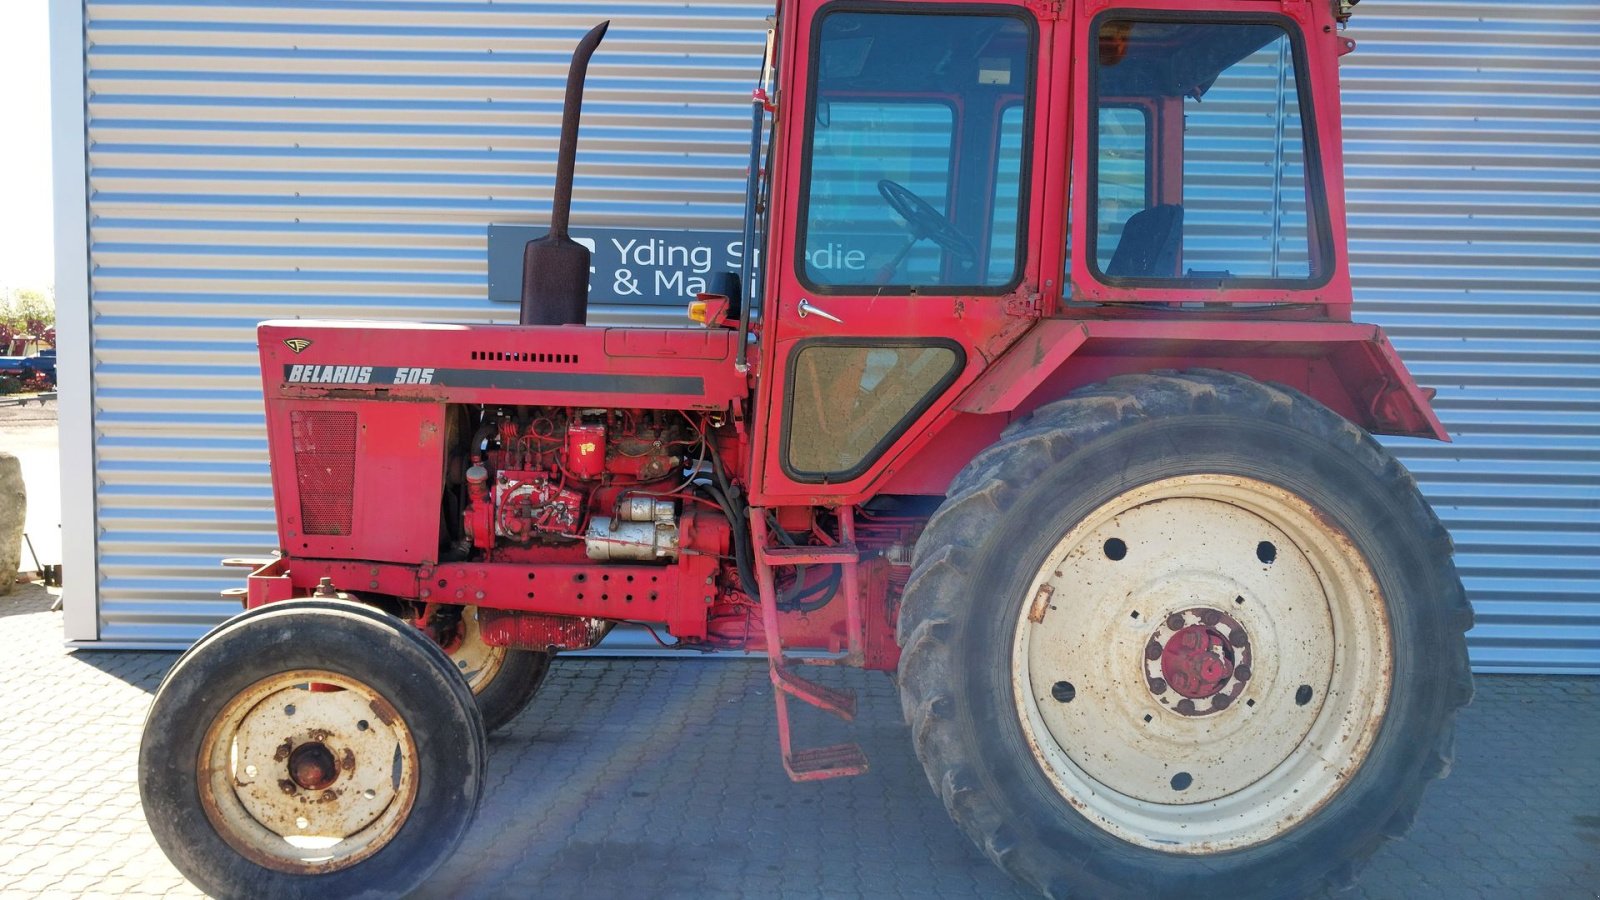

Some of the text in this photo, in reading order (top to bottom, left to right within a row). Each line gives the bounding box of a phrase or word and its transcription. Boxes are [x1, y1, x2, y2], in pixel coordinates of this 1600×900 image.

[611, 238, 712, 273] Yding
[613, 268, 643, 296] &
[288, 364, 435, 385] BELARUS 505
